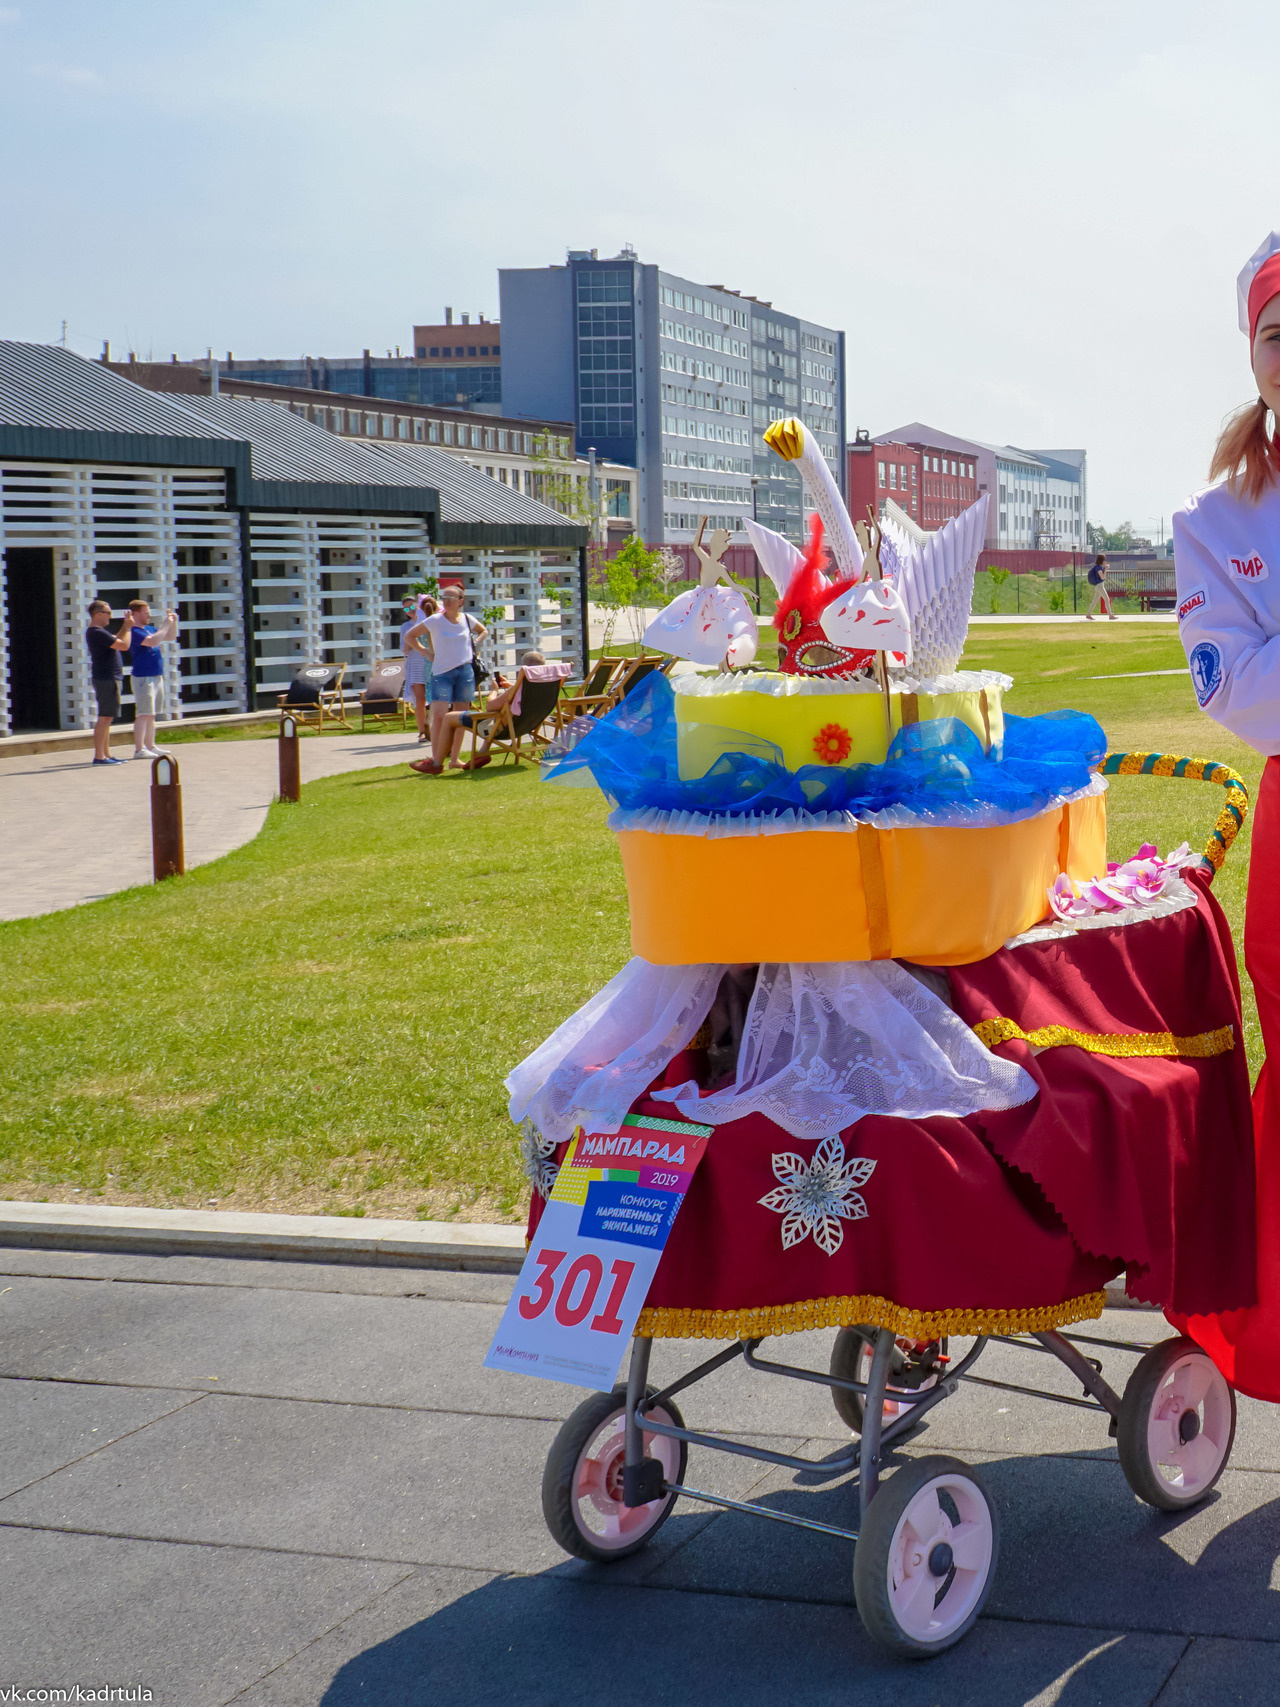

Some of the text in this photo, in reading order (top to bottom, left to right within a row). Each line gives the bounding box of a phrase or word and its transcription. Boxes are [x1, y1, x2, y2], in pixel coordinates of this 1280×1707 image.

[581, 1137, 686, 1165] МАМПАРАД
[650, 1172, 679, 1186] 2019
[620, 1194, 668, 1210] КОНКУРС
[595, 1206, 663, 1223] НАРЯЖЕННЫХ
[601, 1220, 659, 1236] ЭКИПАЖЕЙ
[518, 1248, 636, 1335] 301
